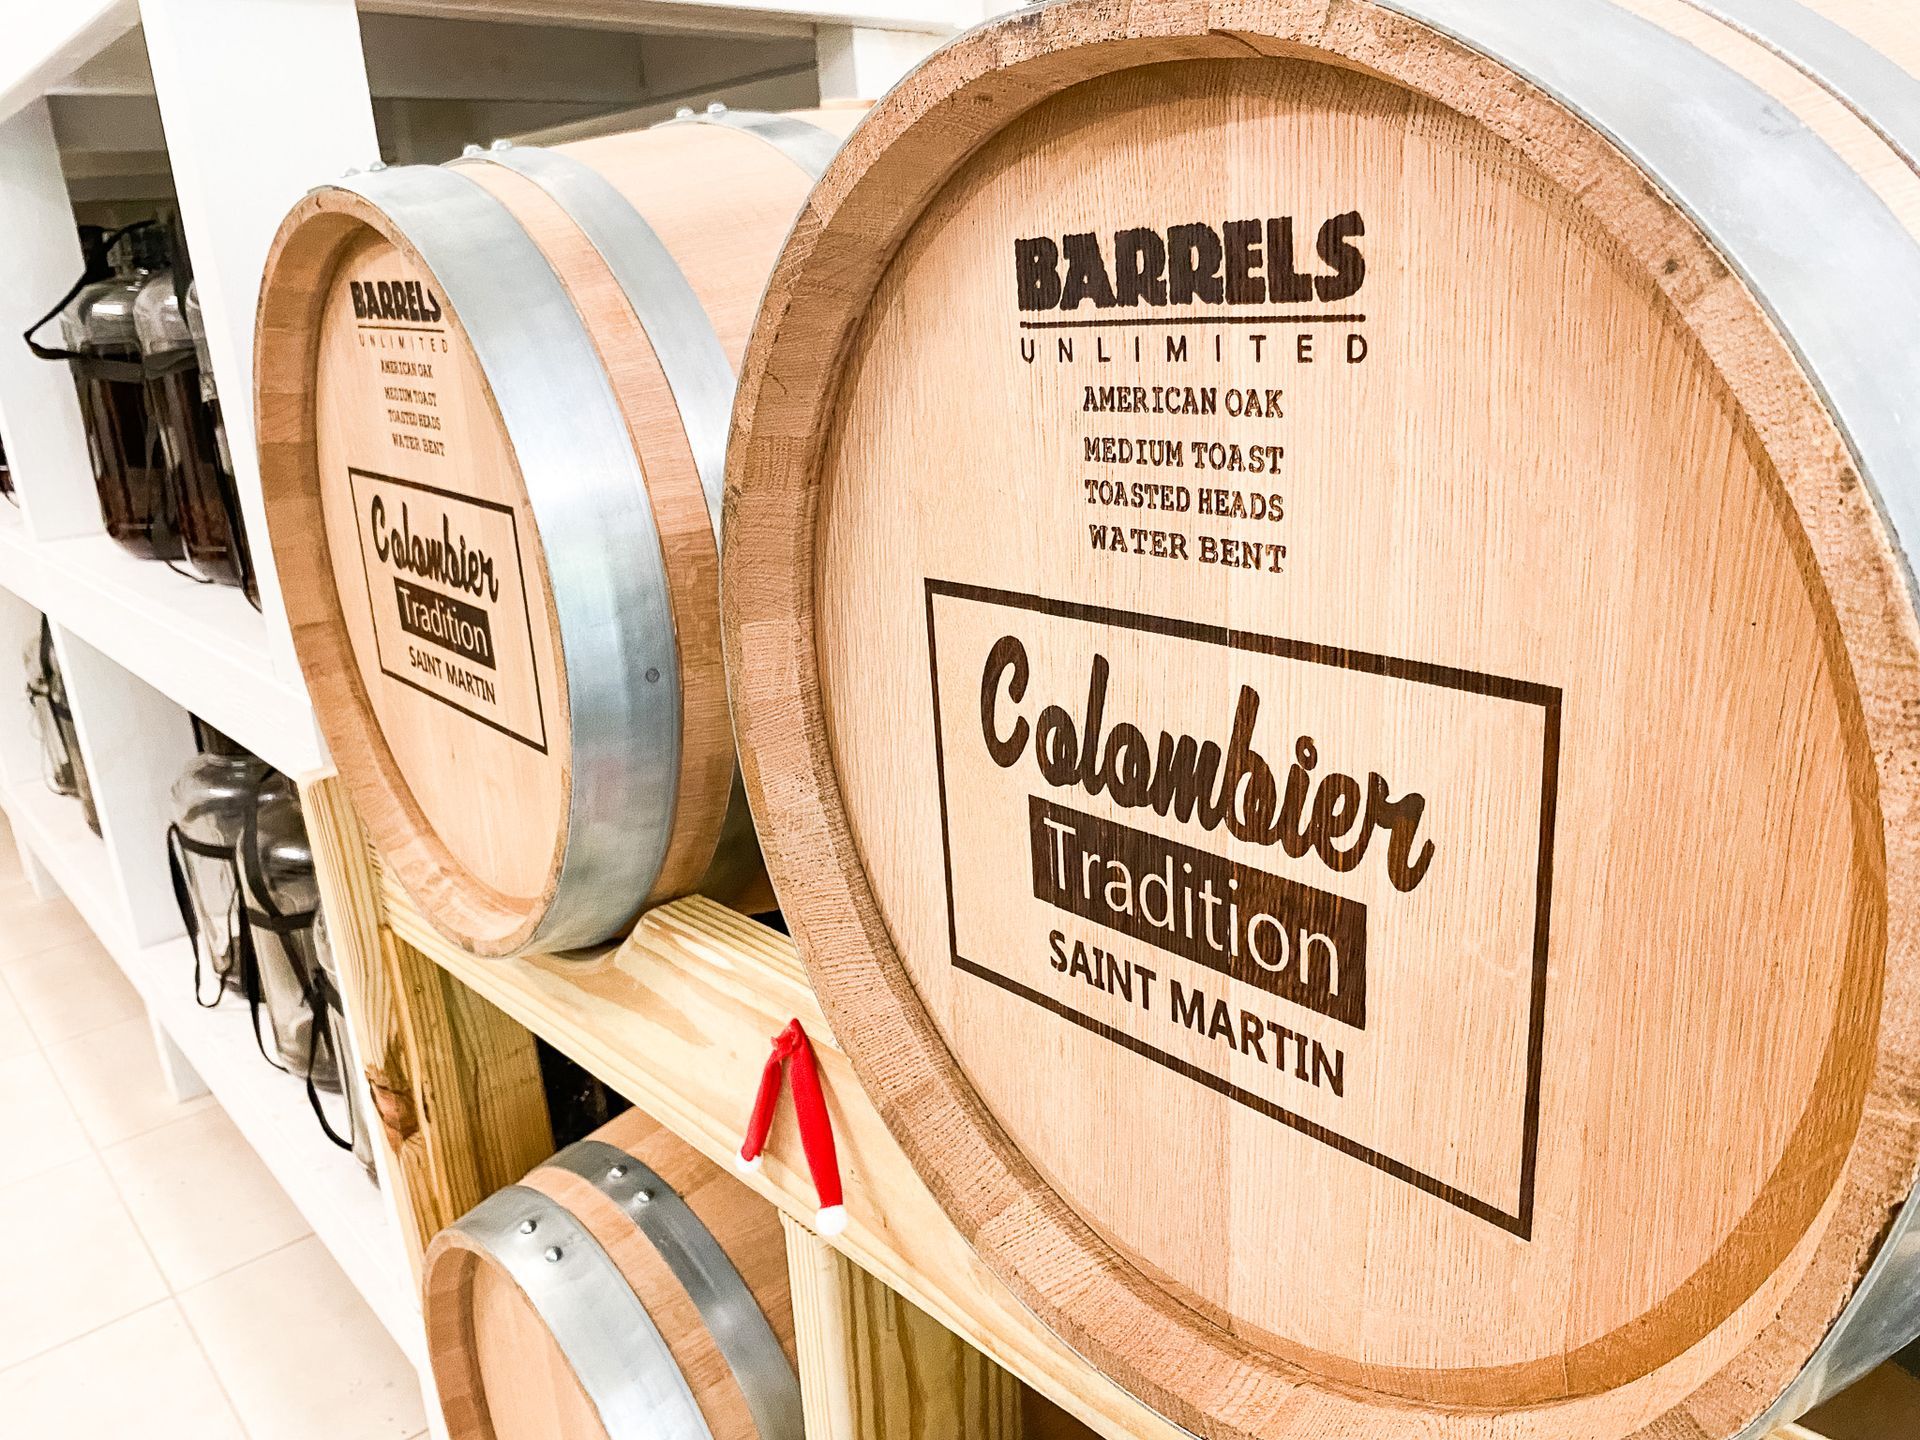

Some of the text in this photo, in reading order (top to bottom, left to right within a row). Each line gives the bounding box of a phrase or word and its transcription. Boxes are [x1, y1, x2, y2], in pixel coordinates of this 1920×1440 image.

[1015, 211, 1365, 311] BARRELS
[359, 335, 448, 353] UNLIMITED
[1020, 334, 1368, 364] UNLIMITED
[381, 359, 433, 379] AMERICAN OAK
[384, 387, 437, 407] MEDIUM TOAST
[1083, 385, 1284, 418] AMERICAN OAK
[388, 409, 441, 430] TOASTED HEADS
[392, 433, 445, 456] WATER BENT
[1084, 437, 1285, 475] MEDIUM TOAST
[1085, 480, 1285, 522] TOASTED HEADS
[371, 494, 499, 603] Colombier
[1089, 524, 1286, 573] WATER BENT
[398, 586, 489, 657] Tradition
[409, 645, 496, 705] SAINT MARTIN
[980, 635, 1435, 893] Colombier
[1044, 817, 1339, 997] Tradition
[1049, 929, 1344, 1098] SAINT MARTIN
